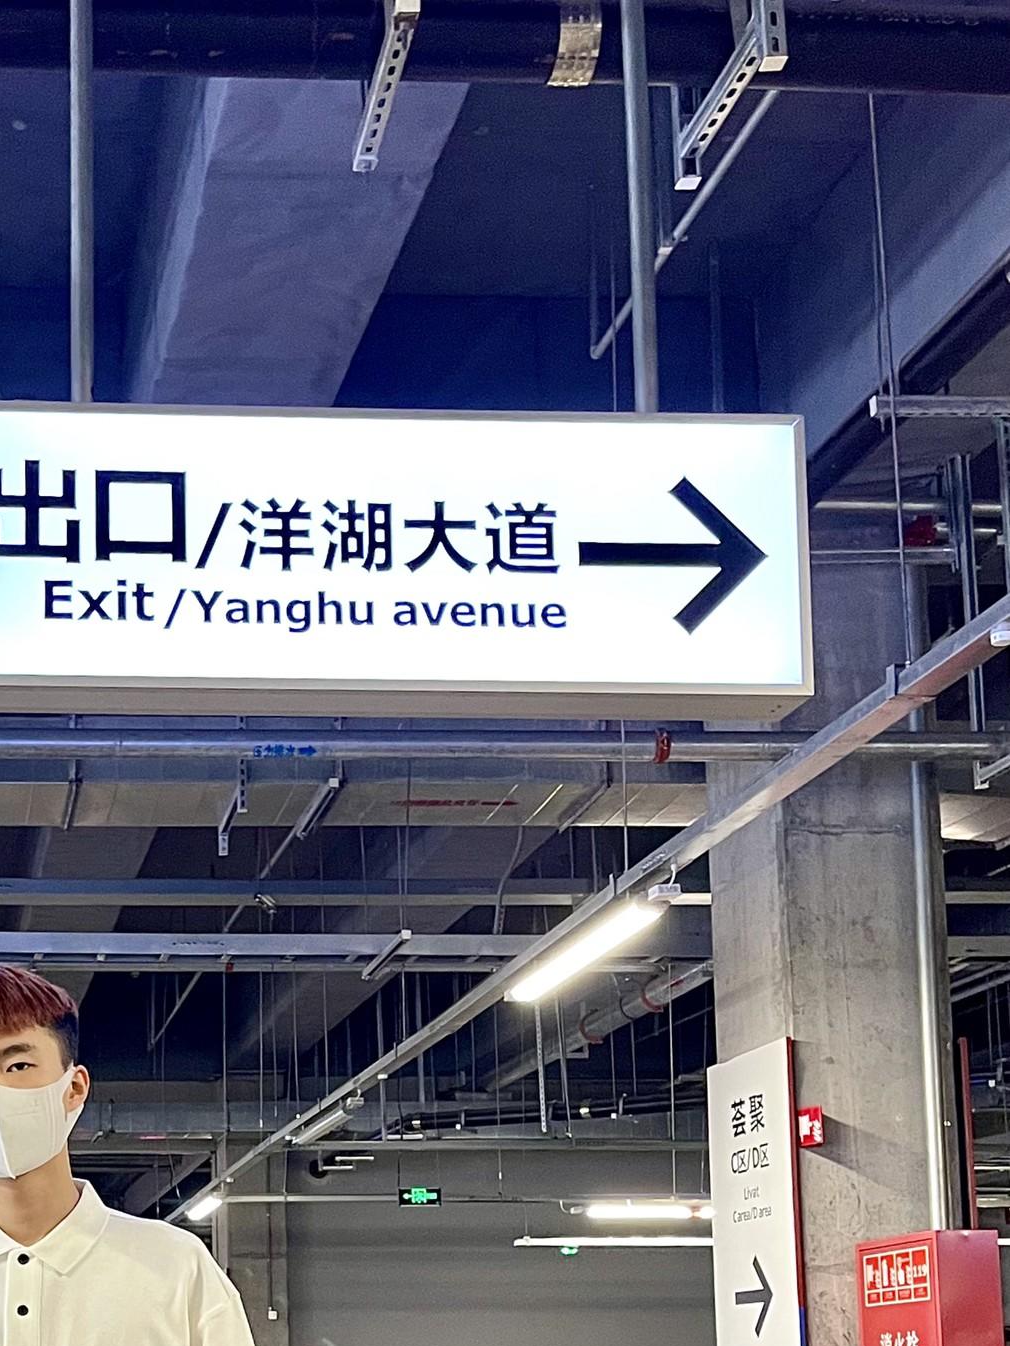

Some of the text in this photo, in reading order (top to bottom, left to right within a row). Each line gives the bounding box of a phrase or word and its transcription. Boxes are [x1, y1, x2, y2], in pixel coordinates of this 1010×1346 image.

[393, 600, 568, 629] avenue
[731, 1093, 765, 1138] 荟聚
[743, 1186, 760, 1201] Livat
